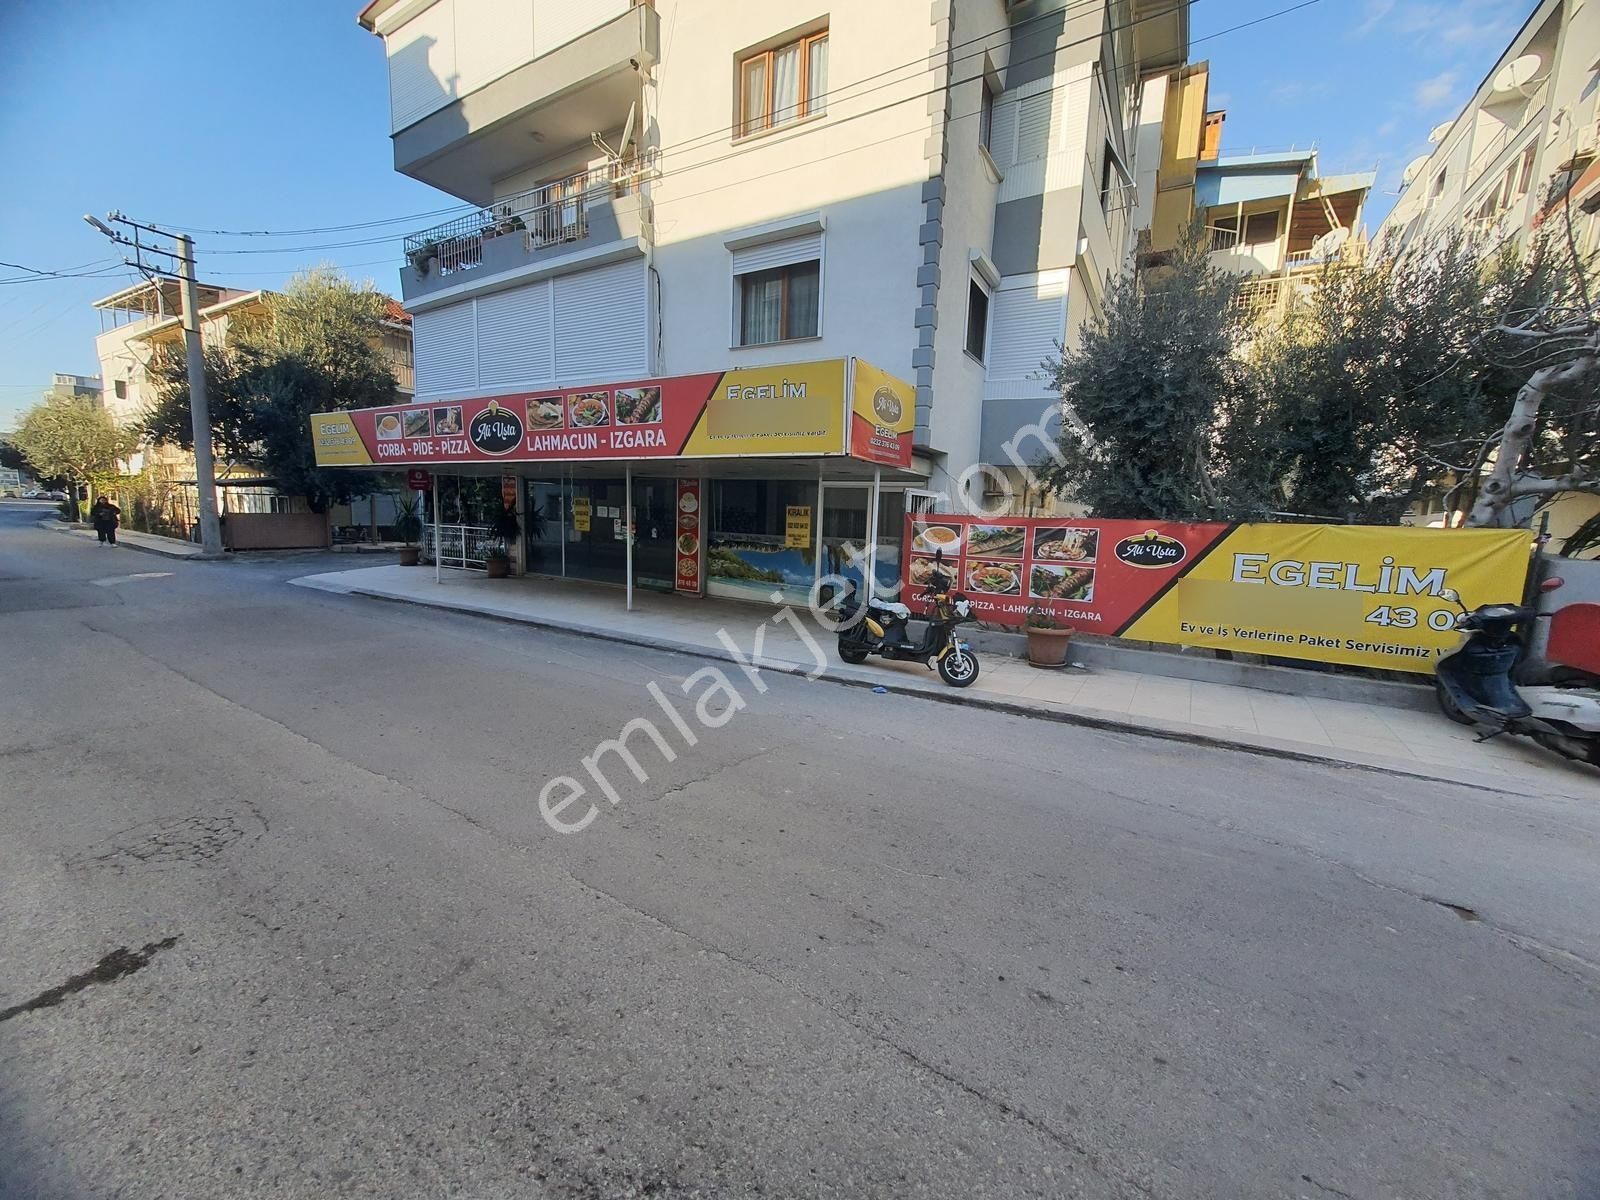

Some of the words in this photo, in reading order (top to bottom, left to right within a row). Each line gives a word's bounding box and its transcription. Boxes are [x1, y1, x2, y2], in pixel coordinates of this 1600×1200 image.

[475, 422, 491, 442] Ali
[492, 421, 516, 441] Usta
[526, 432, 598, 452] LAHMACUN
[610, 428, 667, 449] IZGARA
[377, 442, 407, 458] ÇORBA
[413, 439, 434, 456] PİDE
[441, 437, 471, 455] PİZZA
[1122, 544, 1144, 557] Ali
[1146, 544, 1177, 559] Usta
[1230, 551, 1447, 597] EGELİM
[1064, 608, 1102, 622] IZGARA
[1365, 605, 1418, 629] 43
[1180, 622, 1196, 633] Ev
[1199, 625, 1214, 635] ve
[1217, 623, 1229, 637] İş
[1232, 627, 1294, 643] Yerlerine
[1298, 634, 1341, 649] Paket
[1345, 639, 1431, 658] Servisimiz
